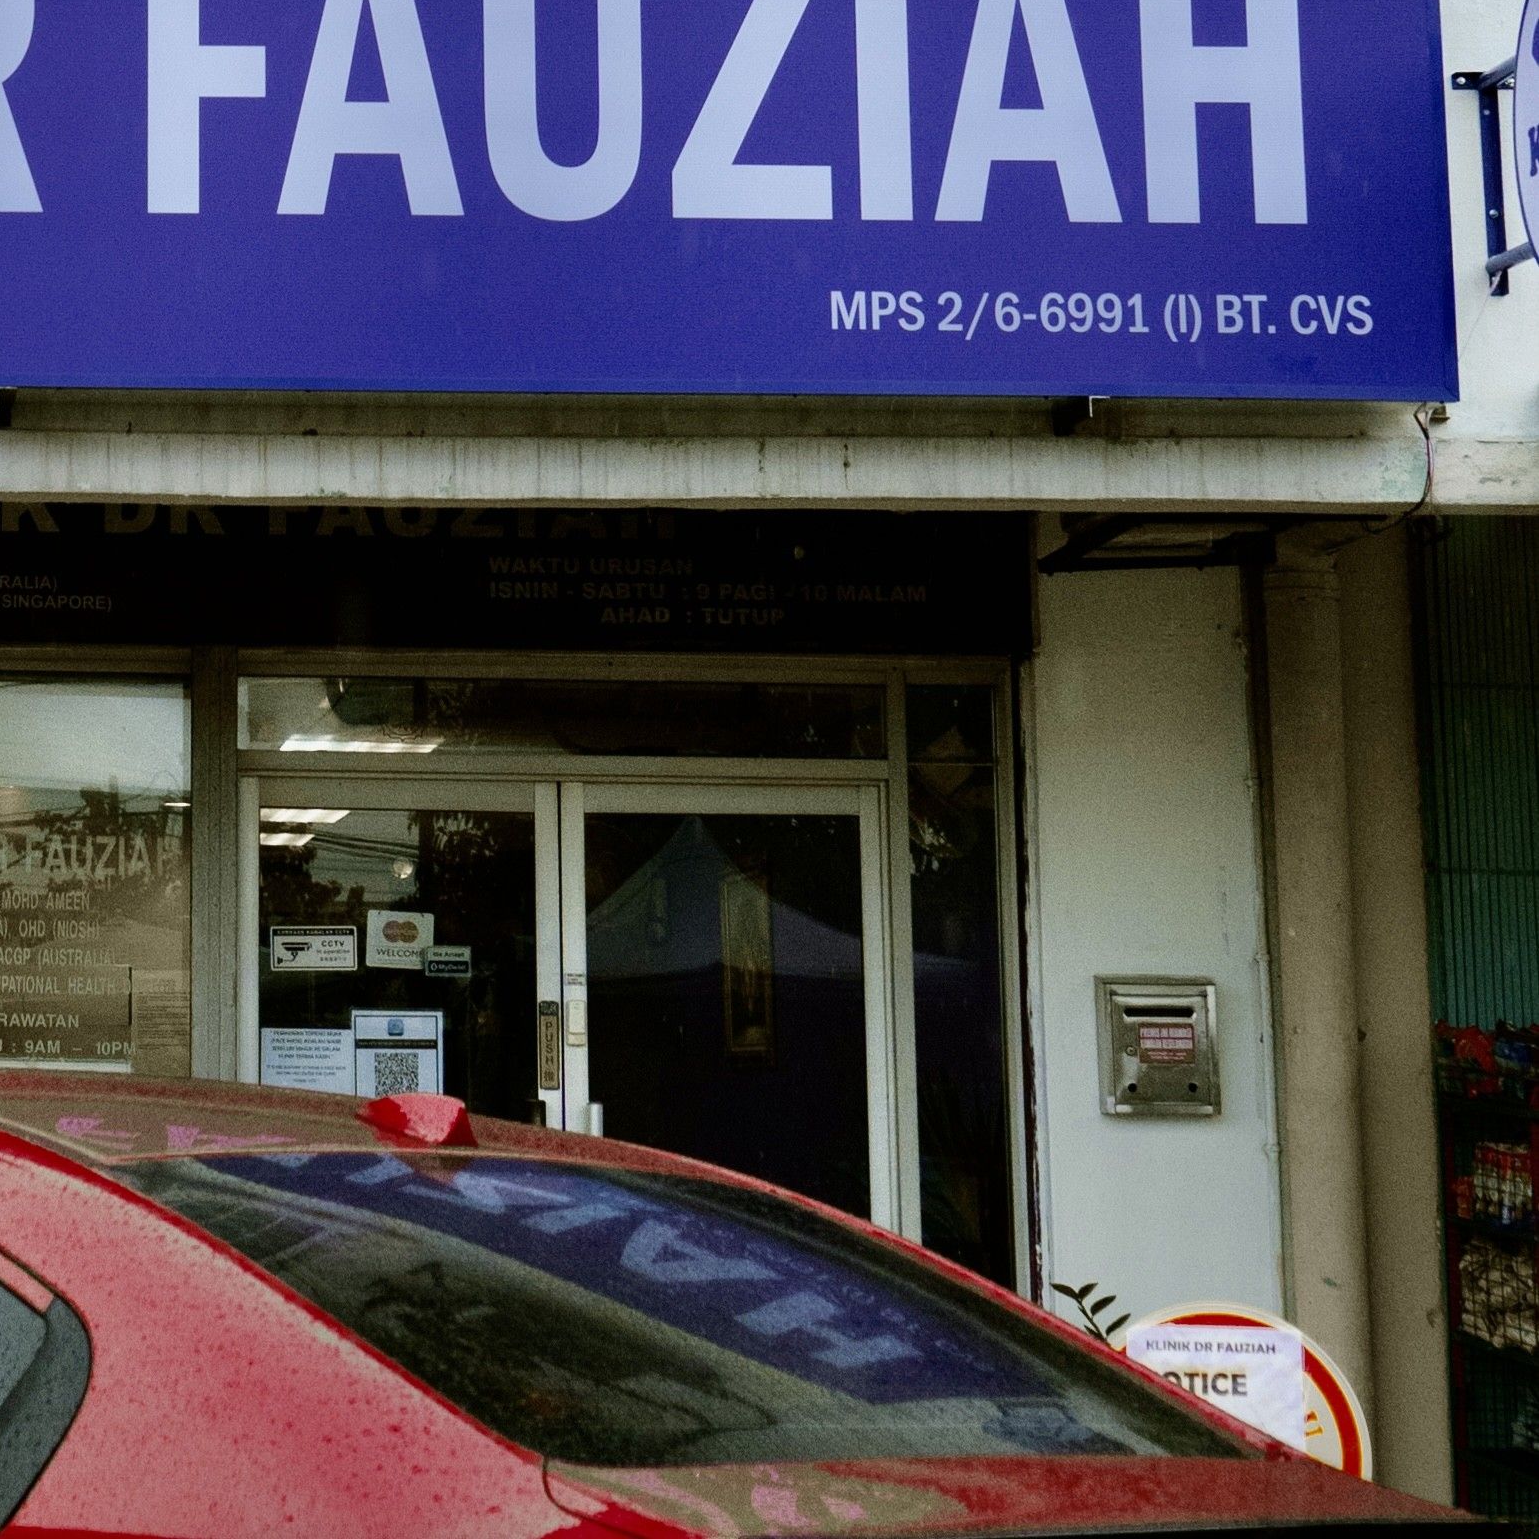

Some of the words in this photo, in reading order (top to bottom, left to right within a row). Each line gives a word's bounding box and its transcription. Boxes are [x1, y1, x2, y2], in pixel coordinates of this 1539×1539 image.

[829, 291, 926, 332] MPS
[937, 291, 1150, 341] 2/6-6991
[1164, 293, 1202, 343] (I)
[1215, 294, 1277, 334] BT.
[1290, 295, 1374, 335] CVS
[487, 555, 580, 576] WAKTU
[590, 556, 694, 577] URUSAN
[489, 580, 558, 600] ISNIN
[581, 581, 669, 600] SABTU
[836, 585, 927, 603] MALAM
[599, 606, 671, 624] AHAD
[701, 608, 787, 625] TUTUP
[1, 891, 39, 908] MOHD
[46, 892, 90, 910] AMEEN
[18, 919, 46, 937] OHD
[321, 940, 345, 948] CCTV
[24, 1040, 61, 1055] 9AM
[96, 1040, 136, 1055] 10PM
[1146, 1340, 1190, 1351] KLINIK
[1194, 1341, 1212, 1352] DR
[1217, 1342, 1276, 1354] FAUZIAH
[1162, 1372, 1247, 1396] OTICE
